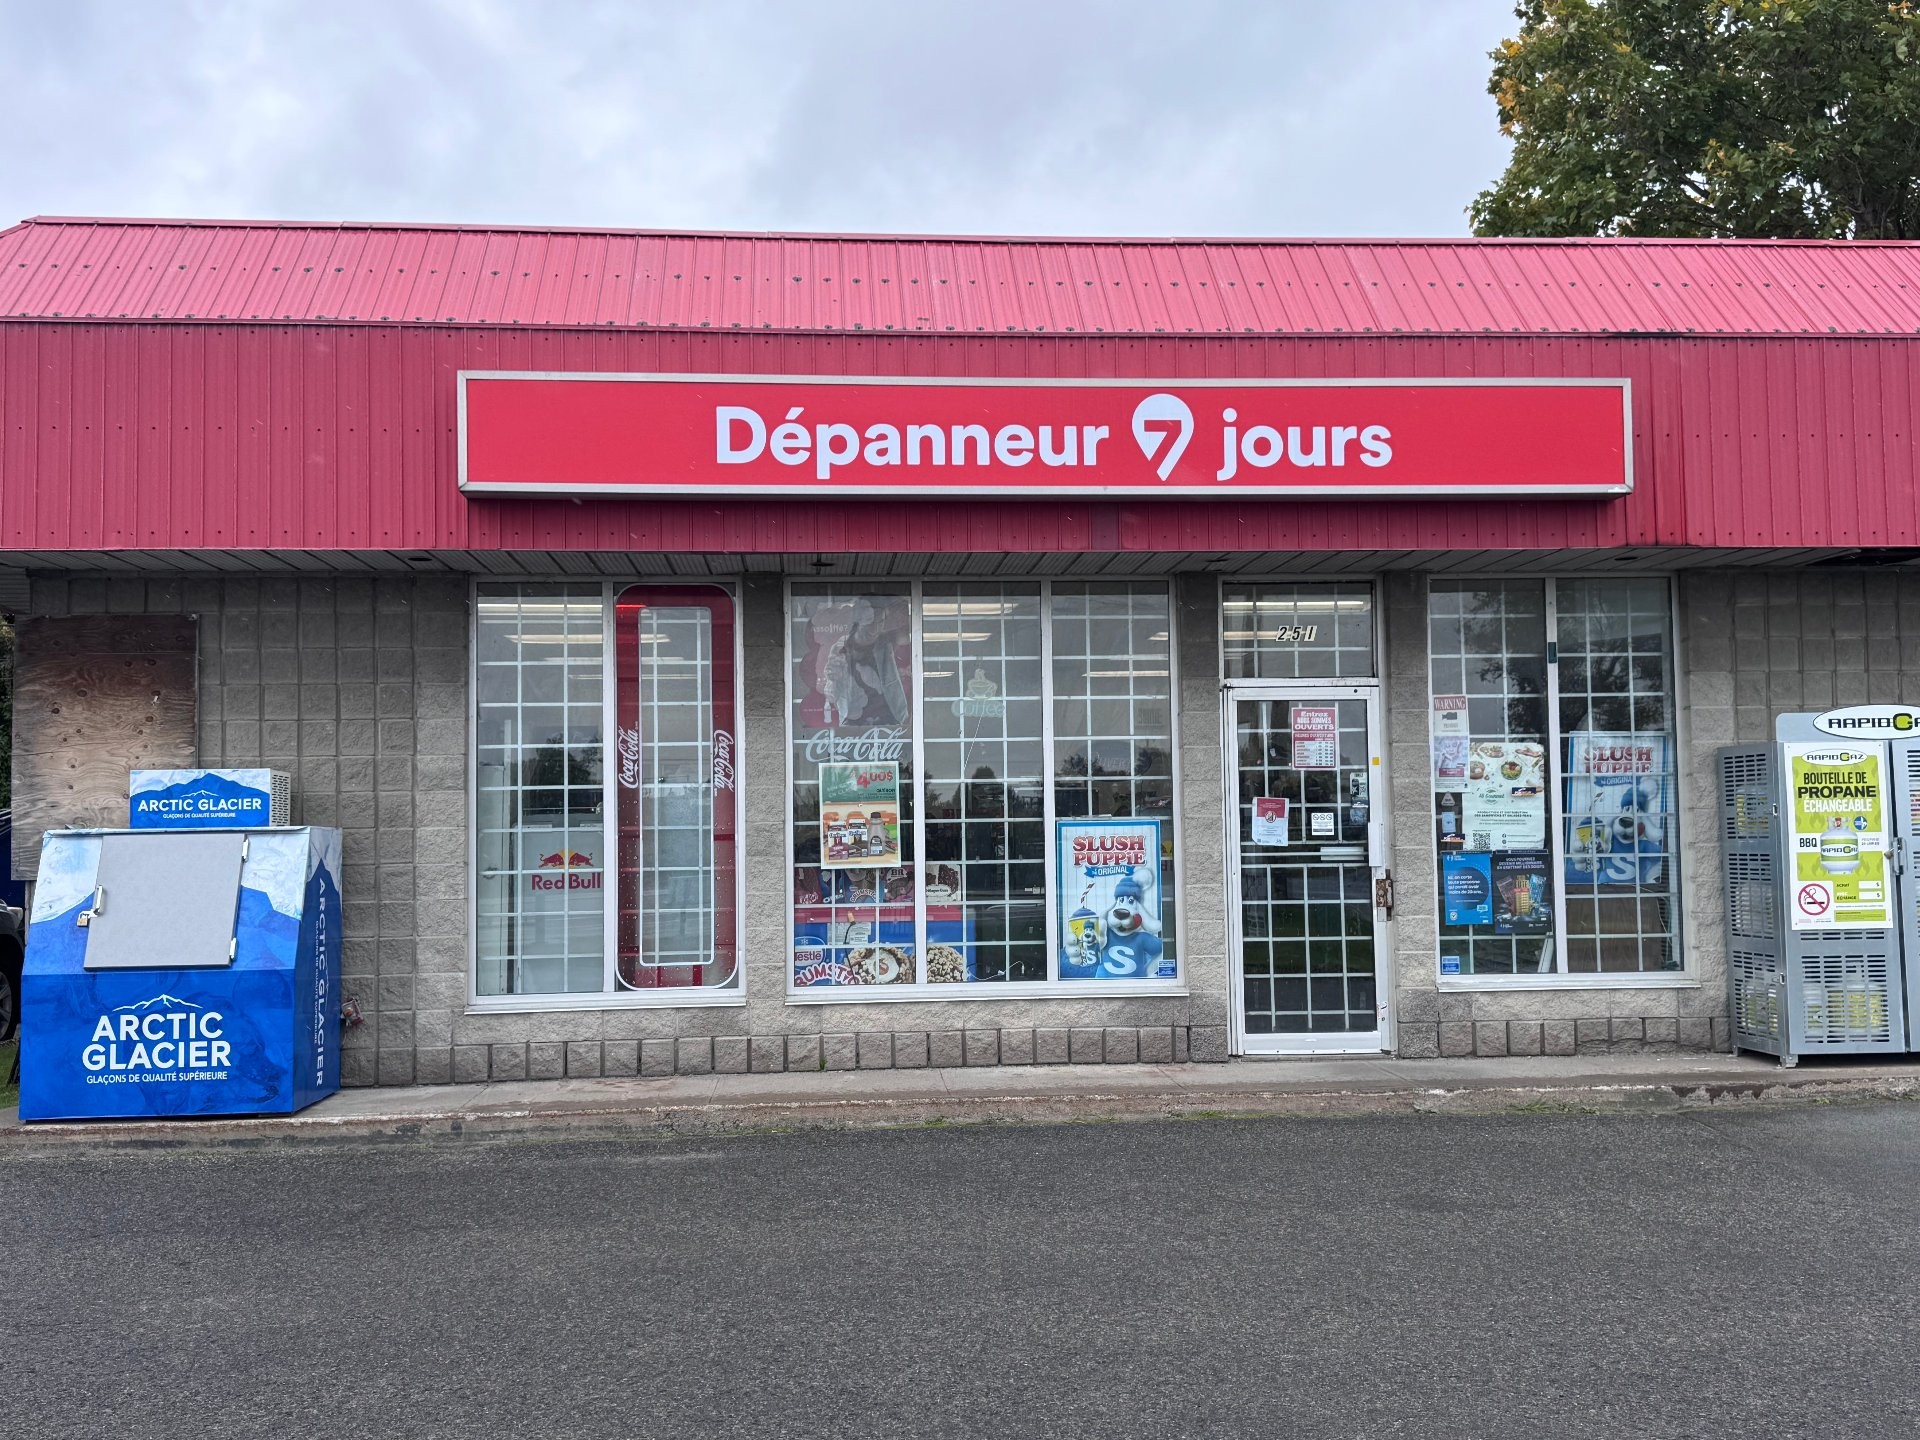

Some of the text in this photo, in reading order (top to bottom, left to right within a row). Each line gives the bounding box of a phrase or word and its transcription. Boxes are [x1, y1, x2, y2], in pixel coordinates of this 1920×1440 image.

[716, 406, 1109, 479] Dépanneur
[1217, 407, 1393, 481] jours
[1278, 626, 1314, 640] 251
[1435, 698, 1466, 710] WARNING
[1804, 772, 1867, 785] BOUTEILLE DE
[1798, 786, 1877, 798] PROPANE
[138, 798, 262, 811] ARCTIC GLACIER
[1804, 797, 1873, 813] ÉCHANGEABLE
[1073, 835, 1145, 852] SLUSH
[1800, 837, 1818, 848] BBQ
[1097, 866, 1130, 876] ORIGINAL
[532, 872, 601, 890] Red Bull
[1104, 946, 1137, 975] S
[316, 878, 327, 1087] ARCTIC GLACIER
[91, 1011, 223, 1042] ARCTIC
[82, 1041, 231, 1071] GLACIER
[86, 1069, 228, 1085] GLAÇONS DE QUALITÉ SUPÉRIEURE
